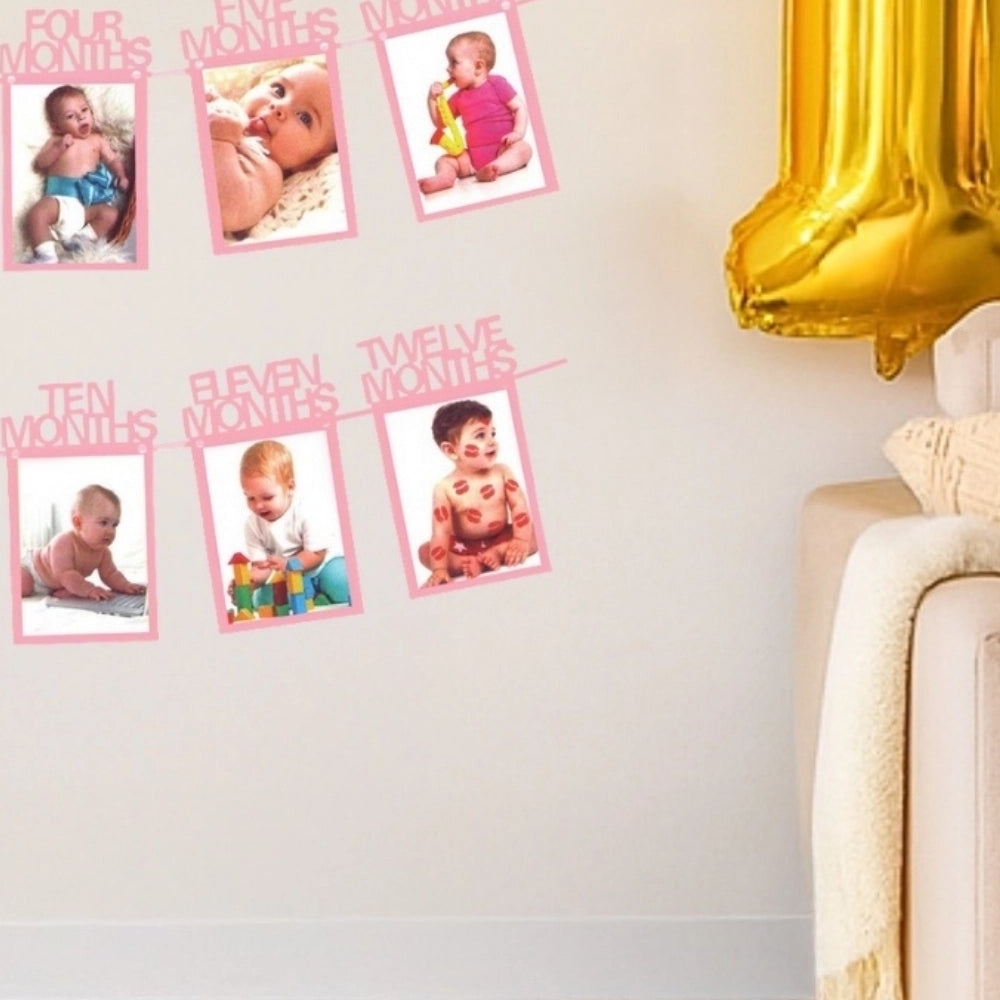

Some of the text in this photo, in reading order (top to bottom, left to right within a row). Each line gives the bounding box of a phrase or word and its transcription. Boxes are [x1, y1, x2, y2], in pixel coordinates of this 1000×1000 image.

[25, 9, 124, 41] FOUR
[180, 7, 340, 62] MONTHS
[1, 36, 152, 74] MONTHS
[356, 315, 504, 371] TWELVE
[39, 379, 115, 416] TEN
[190, 355, 322, 406] ELEVEN
[361, 339, 517, 405] MONTHS
[1, 408, 158, 448] MONTHS
[182, 382, 340, 440] MONTHS
